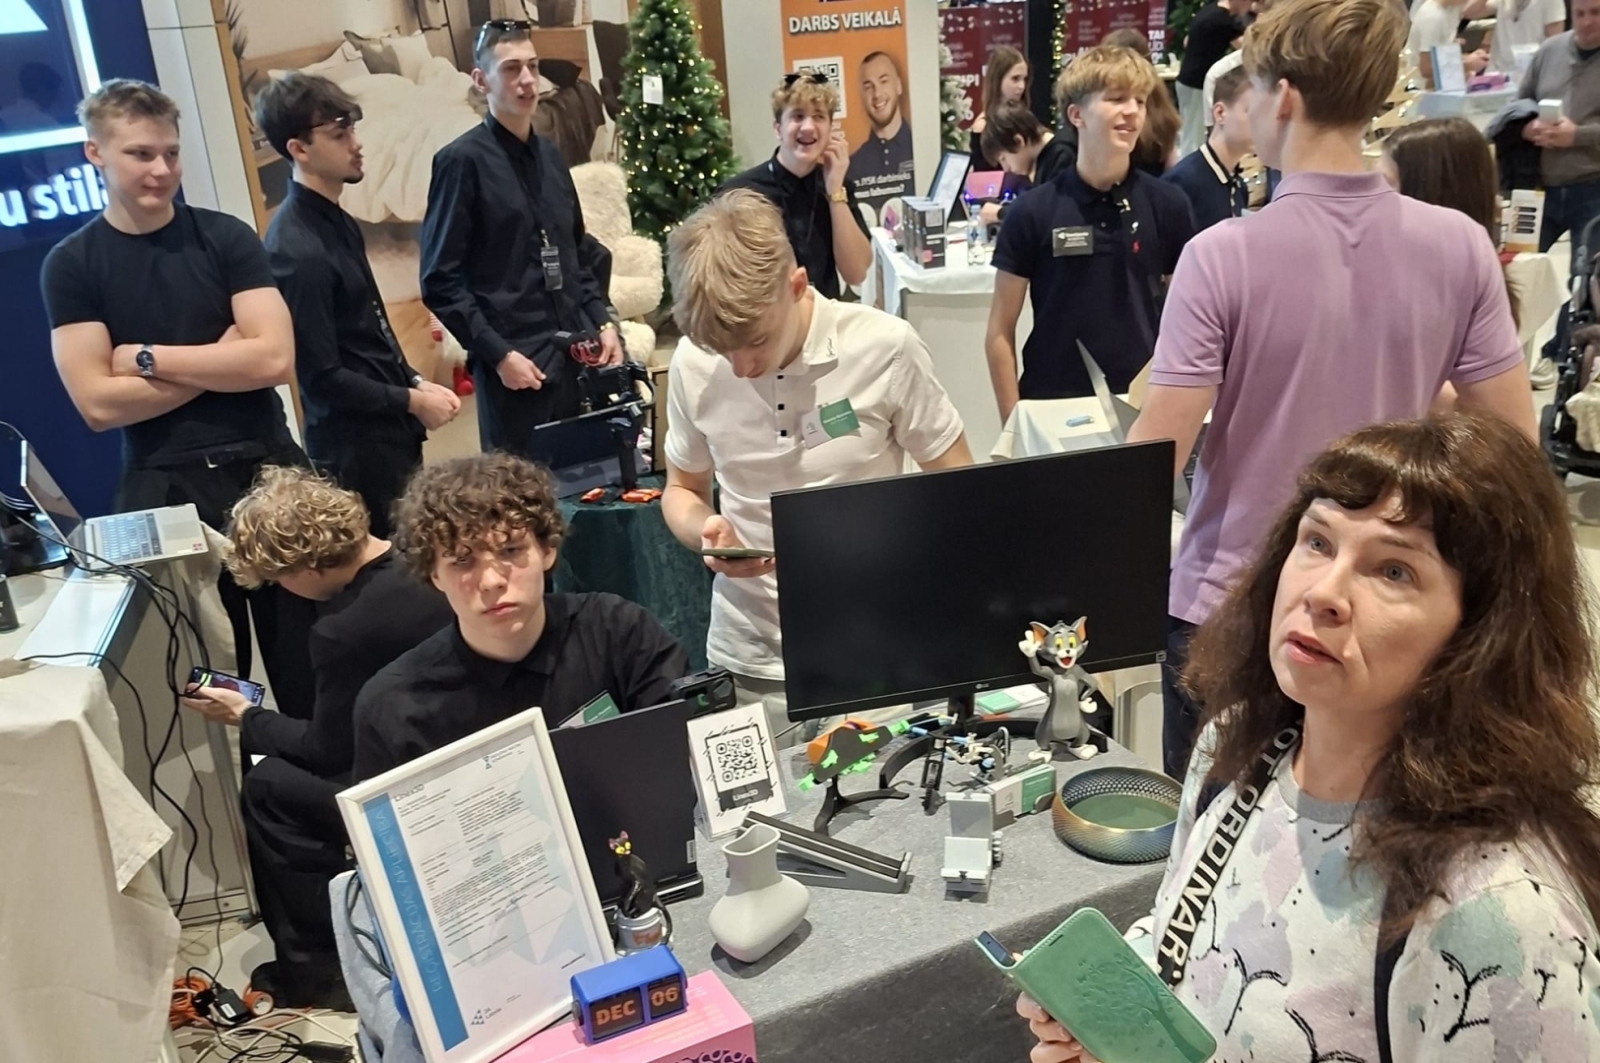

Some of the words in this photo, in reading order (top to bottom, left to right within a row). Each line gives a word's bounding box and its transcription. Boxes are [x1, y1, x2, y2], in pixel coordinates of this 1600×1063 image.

[789, 14, 840, 34] DARBS
[841, 6, 902, 29] VEIKALĀ
[1260, 719, 1303, 776] OT
[595, 1000, 637, 1025] DEC
[650, 987, 680, 1007] 06
